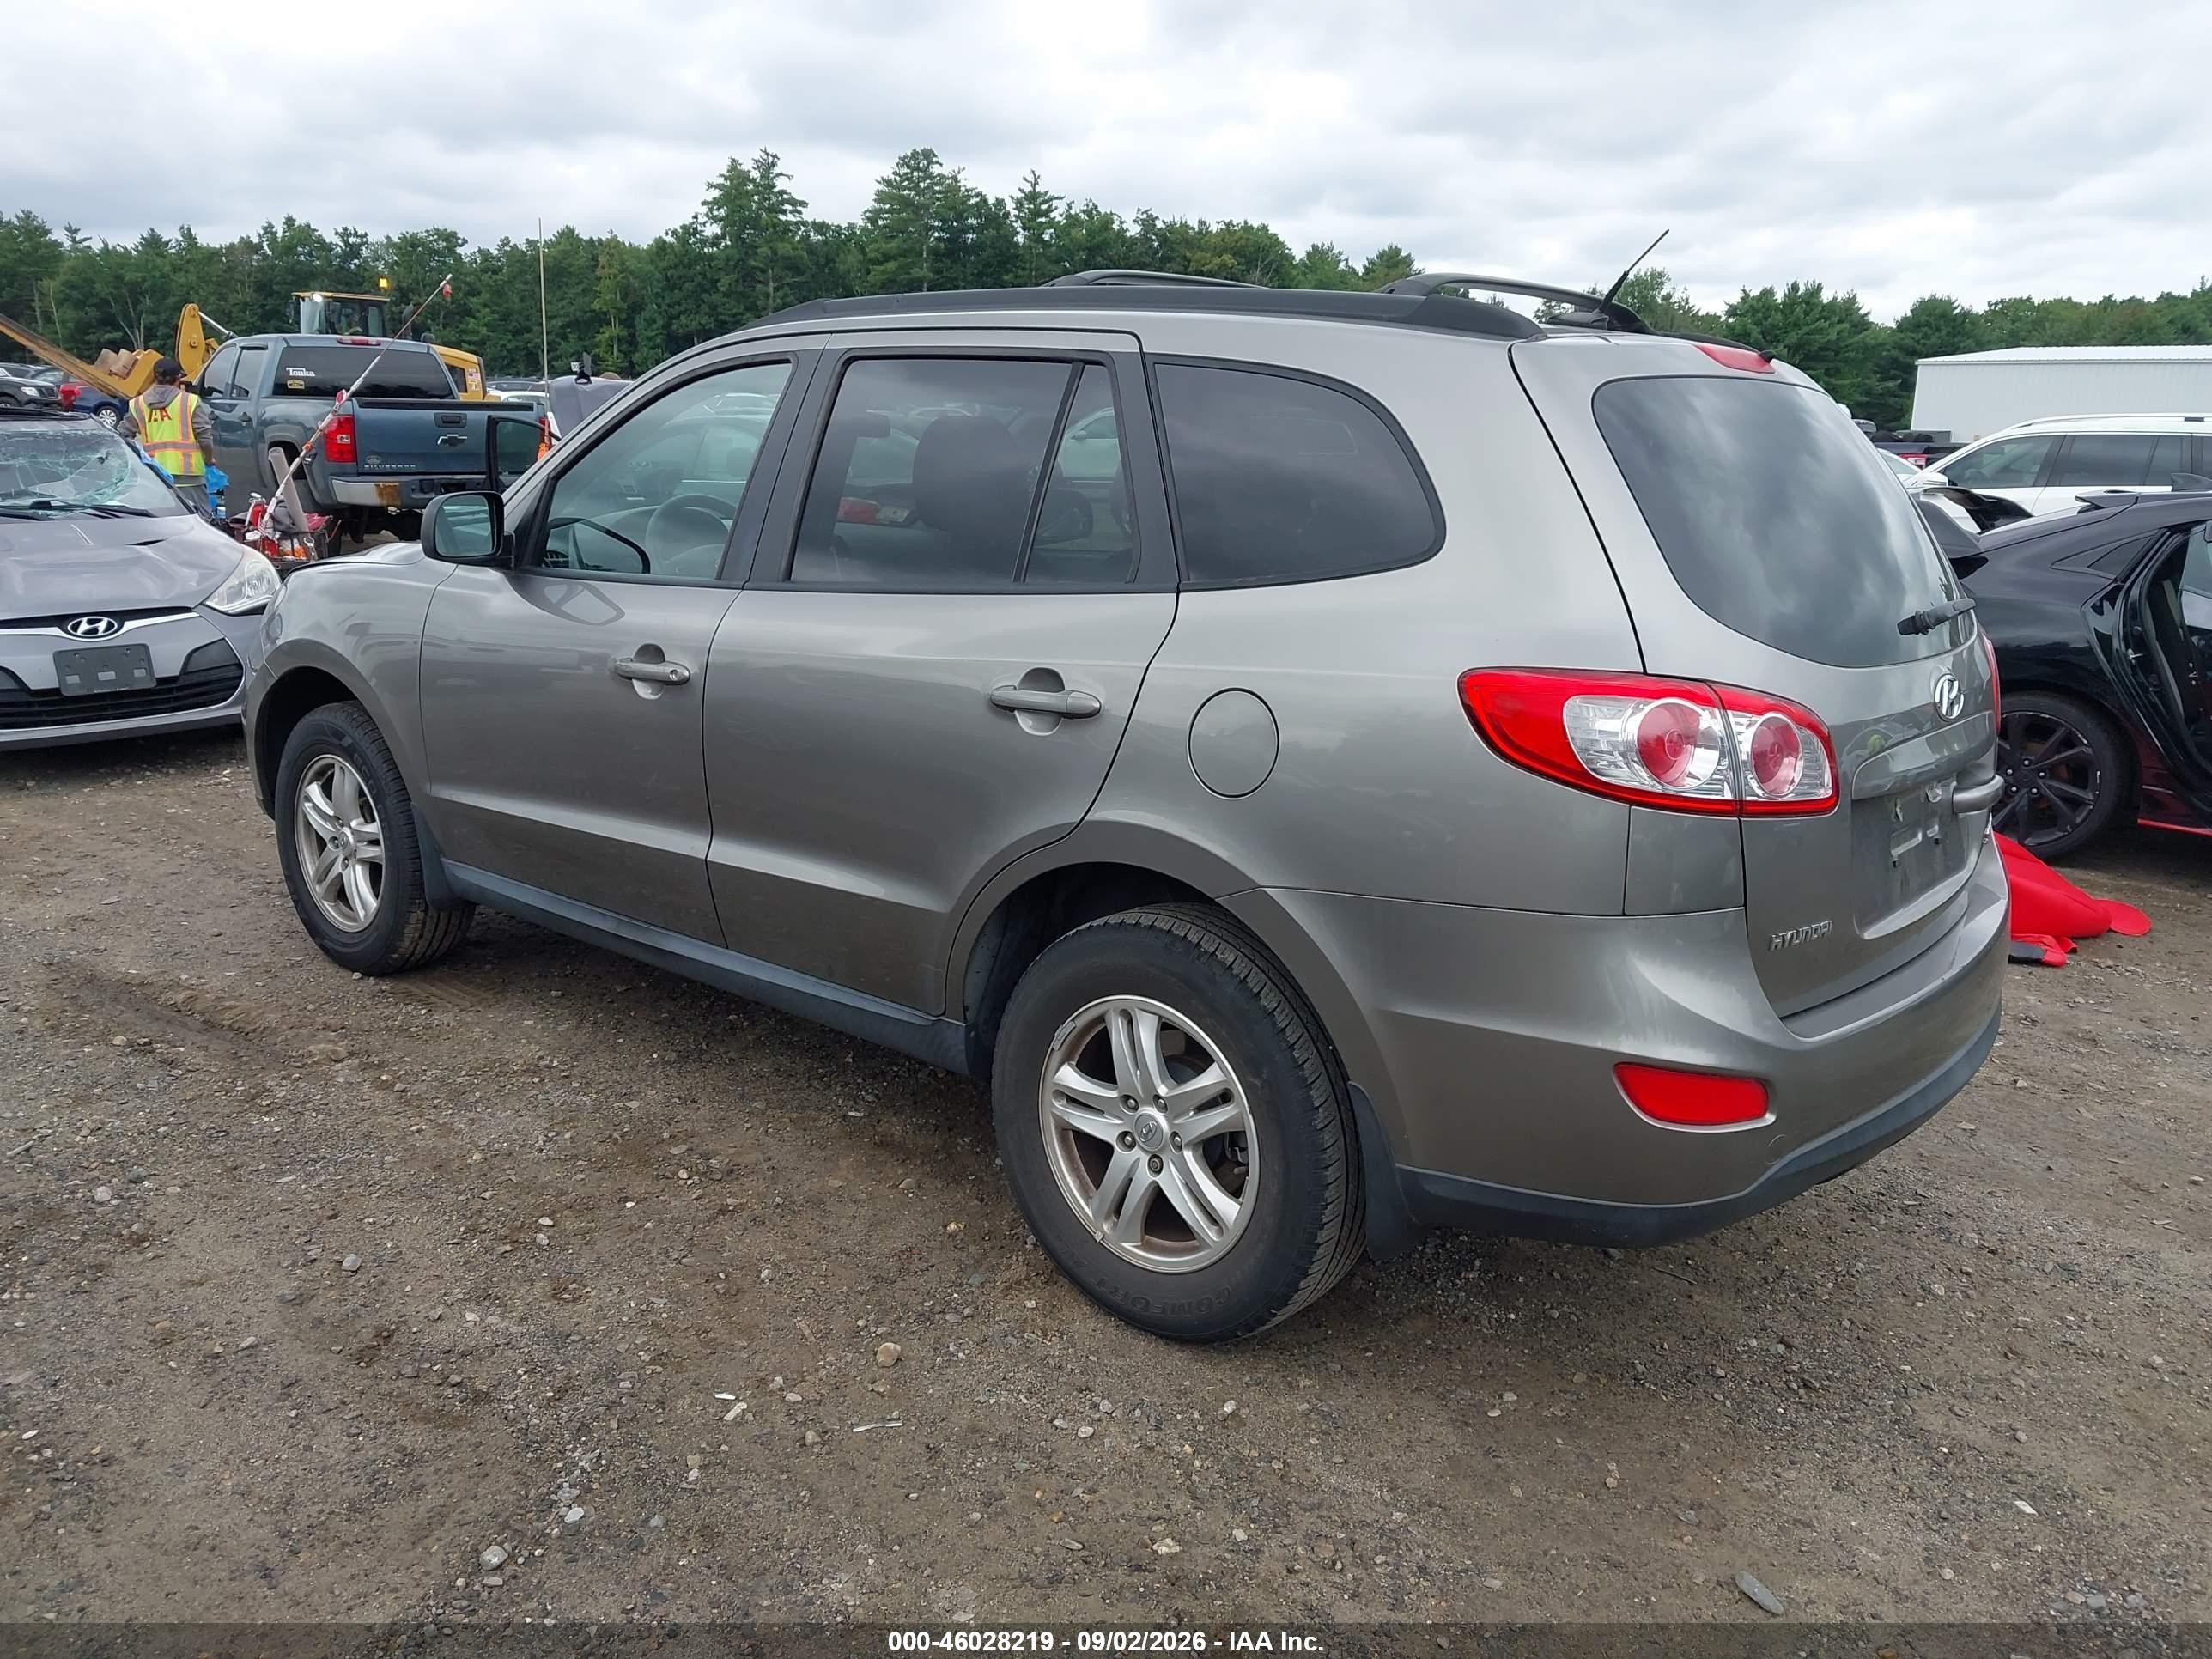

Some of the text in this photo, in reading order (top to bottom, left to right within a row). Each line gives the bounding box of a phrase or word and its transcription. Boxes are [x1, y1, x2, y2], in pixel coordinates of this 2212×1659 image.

[286, 367, 316, 377] Tonka
[1770, 920, 1832, 951] HYUNDAI
[1091, 1277, 1231, 1317] COMFORT
